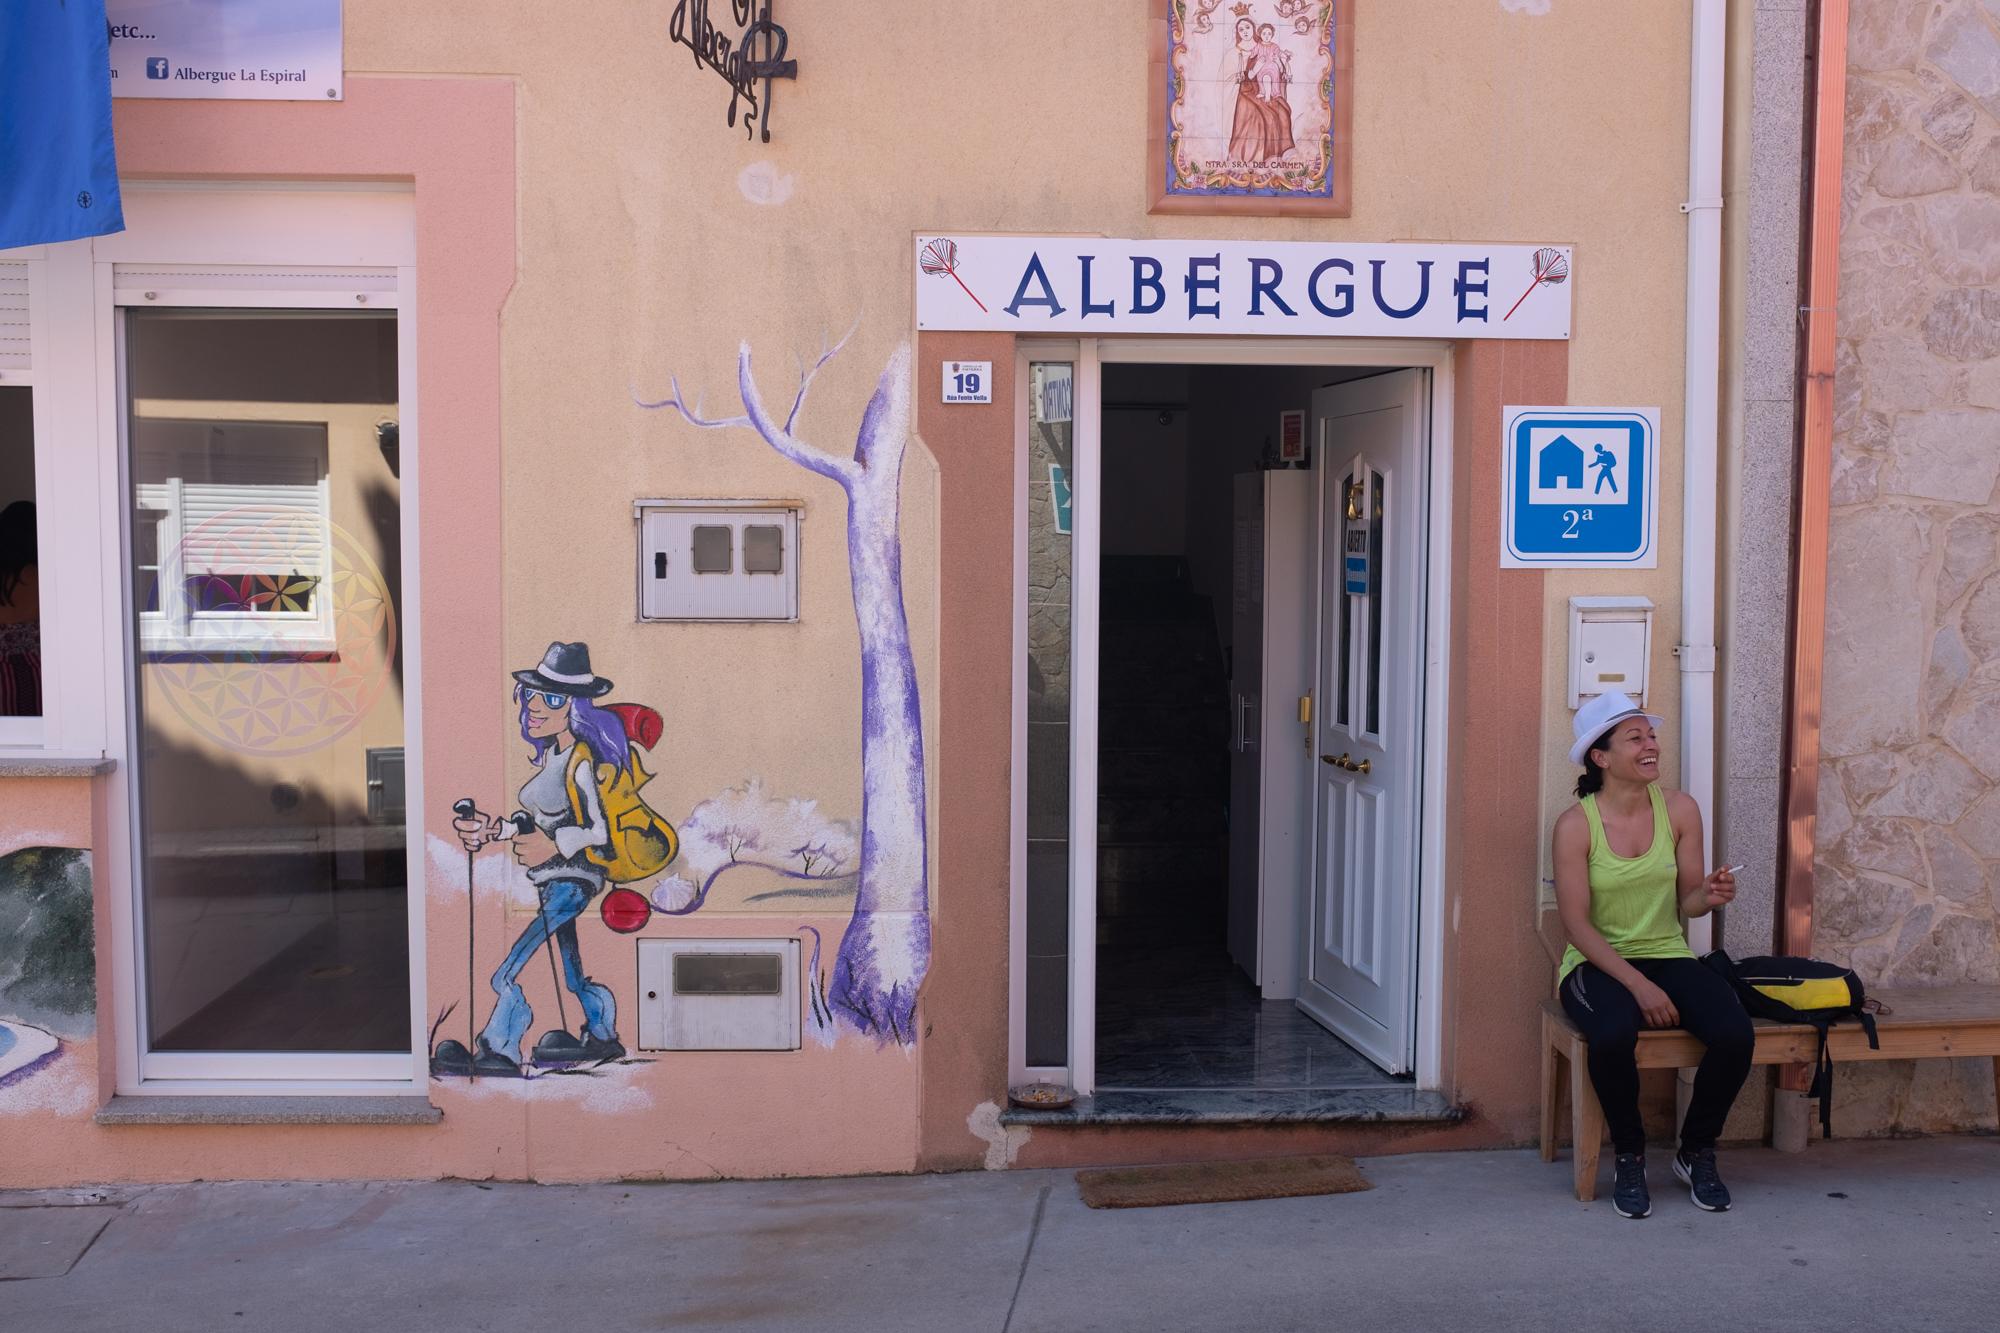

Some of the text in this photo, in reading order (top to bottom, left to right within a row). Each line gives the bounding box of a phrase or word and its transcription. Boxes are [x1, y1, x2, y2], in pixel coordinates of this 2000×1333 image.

[174, 67, 236, 84] Albergue
[240, 69, 256, 81] La
[260, 69, 306, 85] Espiral
[1252, 161, 1269, 169] DEL
[1271, 162, 1304, 170] CARMEN
[1003, 251, 1490, 324] ALBERGUE
[953, 373, 980, 393] 19
